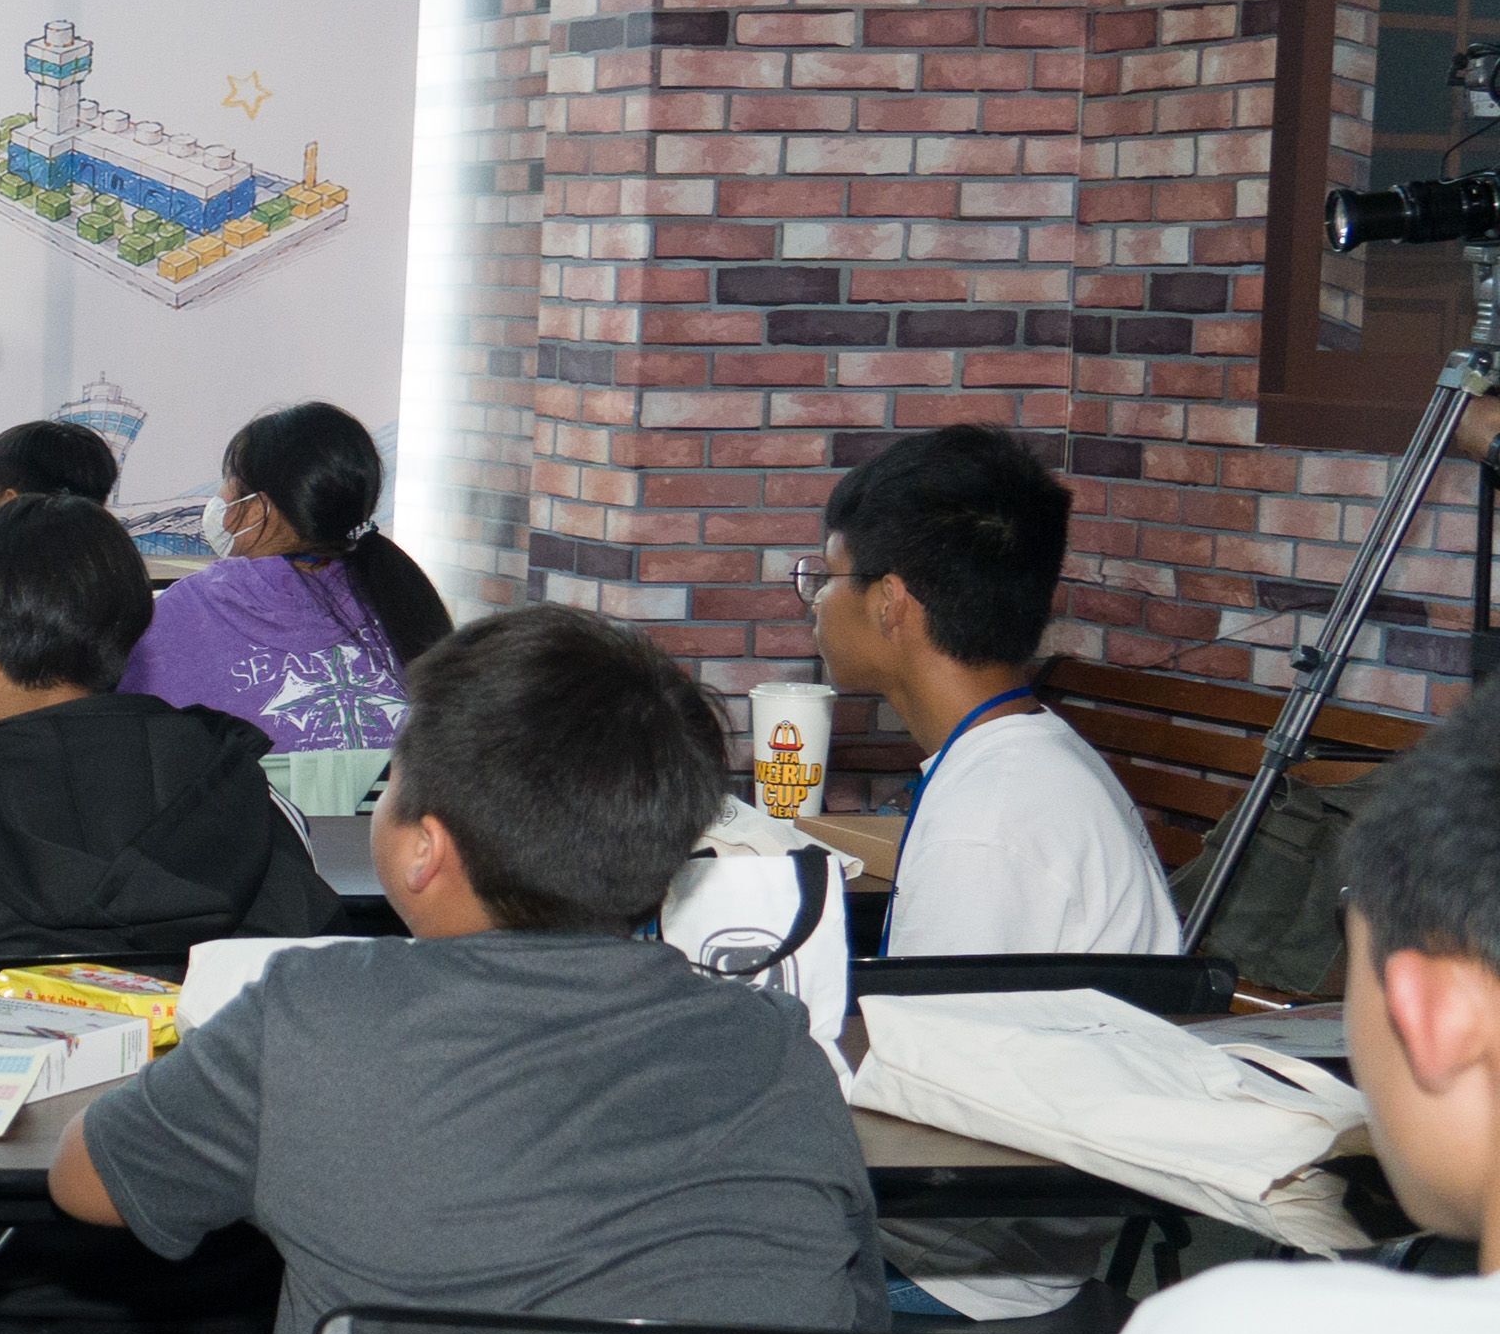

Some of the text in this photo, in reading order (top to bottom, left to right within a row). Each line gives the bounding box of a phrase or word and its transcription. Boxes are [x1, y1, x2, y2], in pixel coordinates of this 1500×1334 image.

[772, 751, 800, 765] FIFA
[755, 758, 823, 787] WORLD
[763, 785, 809, 808] CUP
